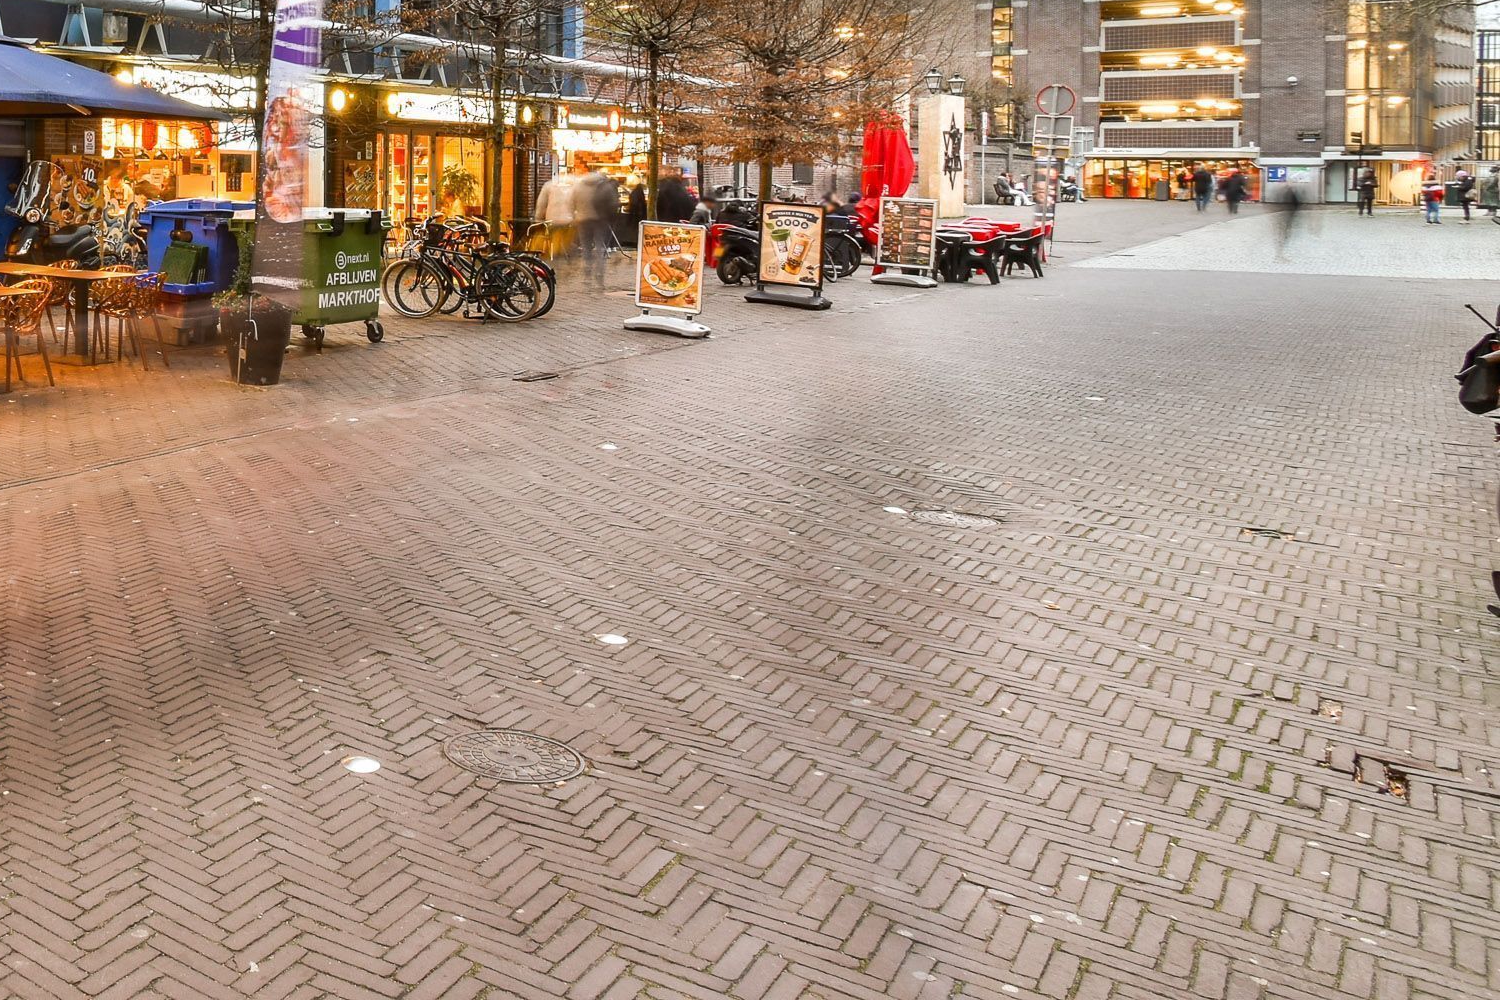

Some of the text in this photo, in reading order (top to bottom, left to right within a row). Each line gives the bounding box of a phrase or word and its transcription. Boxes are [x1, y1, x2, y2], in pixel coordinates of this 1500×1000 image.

[1277, 168, 1286, 178] P
[645, 237, 675, 247] RAMEN
[326, 269, 377, 286] AFBLIJVEN
[318, 288, 380, 309] MARKTHOF
